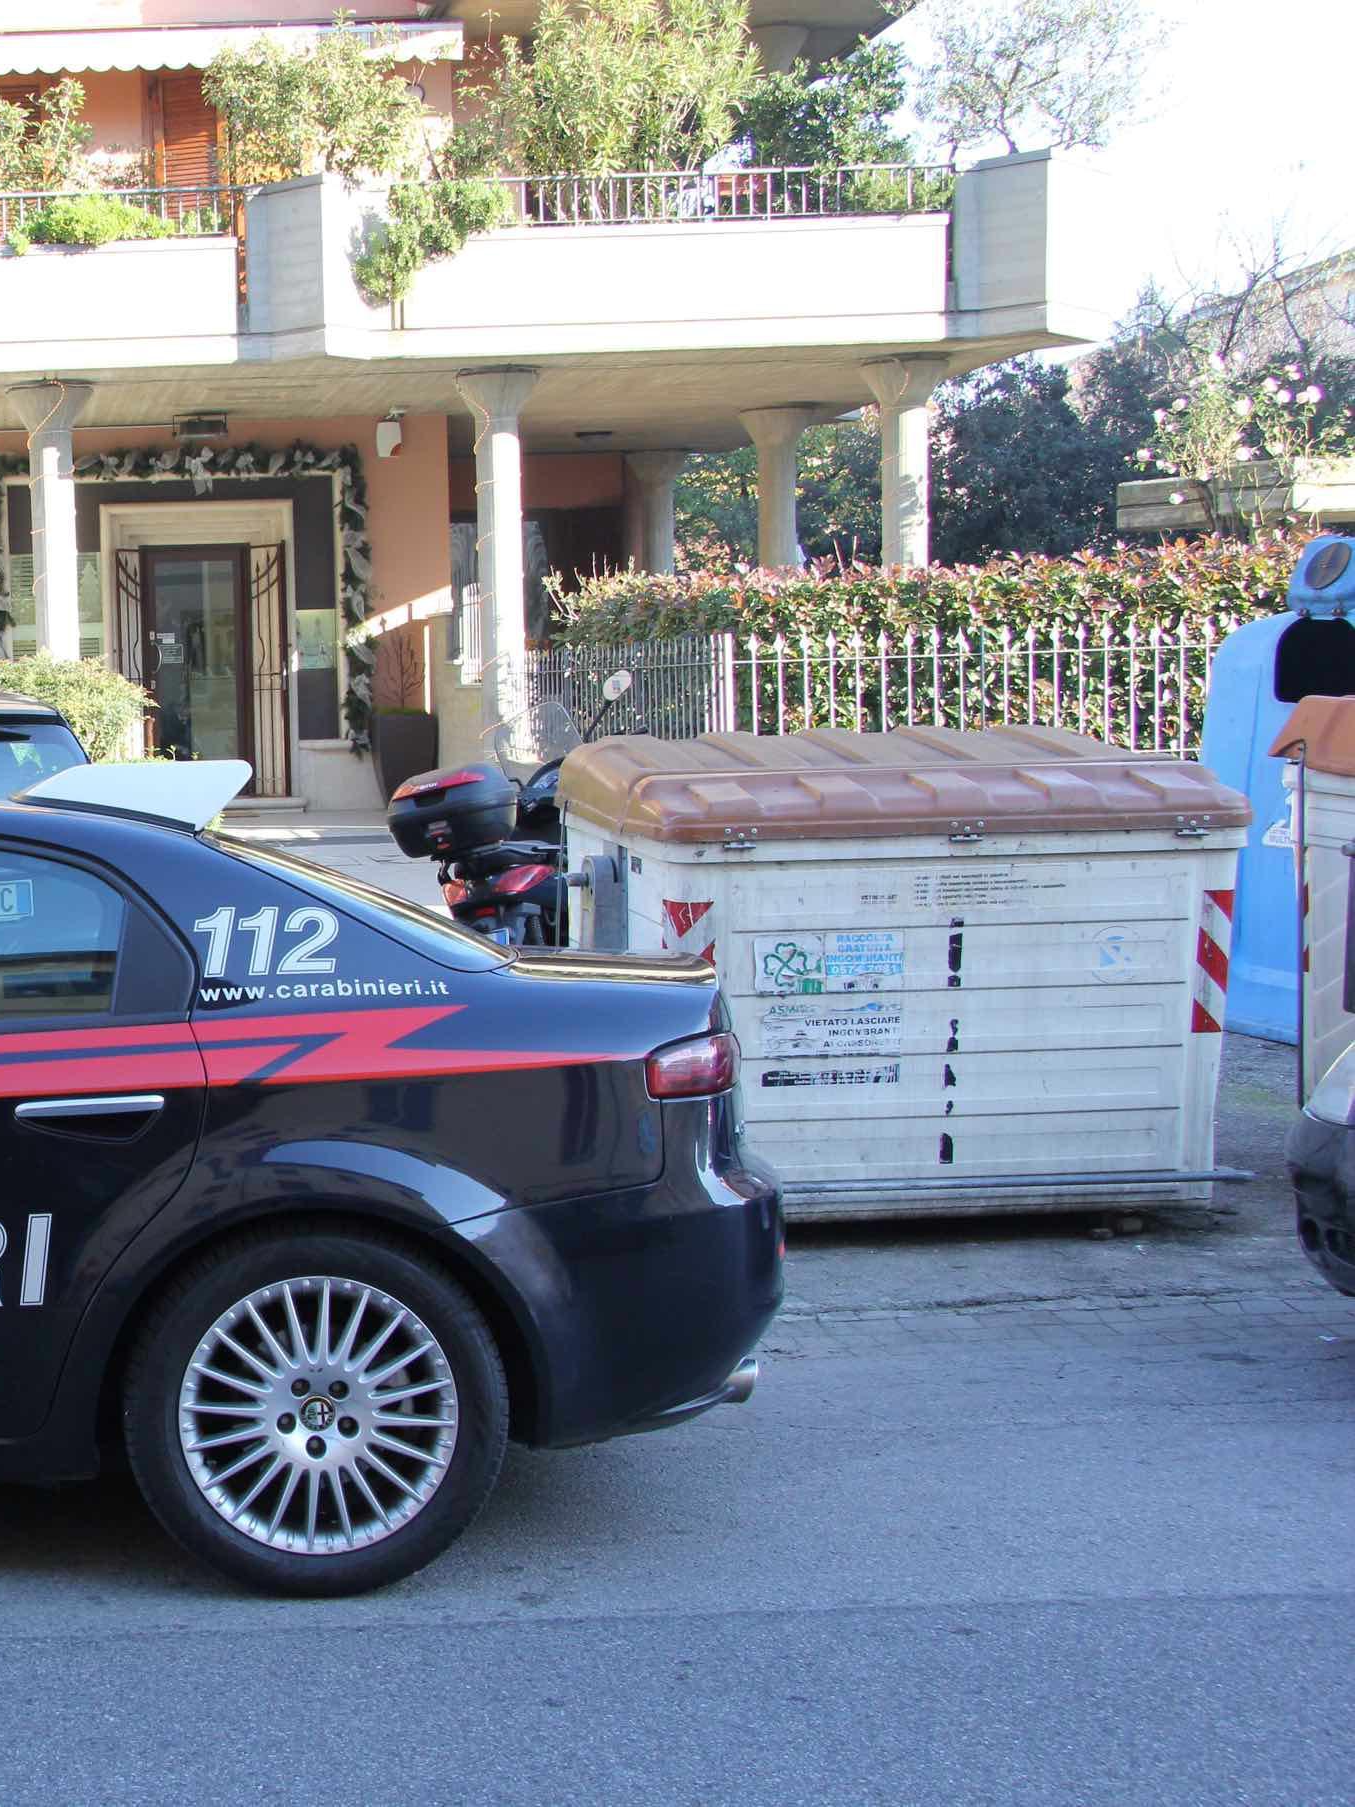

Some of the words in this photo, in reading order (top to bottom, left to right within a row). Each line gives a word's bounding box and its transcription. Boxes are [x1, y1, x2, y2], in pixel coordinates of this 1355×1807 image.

[194, 906, 340, 978] 112
[200, 978, 450, 1002] www.carabinieri.it
[805, 1018, 848, 1027] VIETATO
[851, 1015, 901, 1026] LASCIARE
